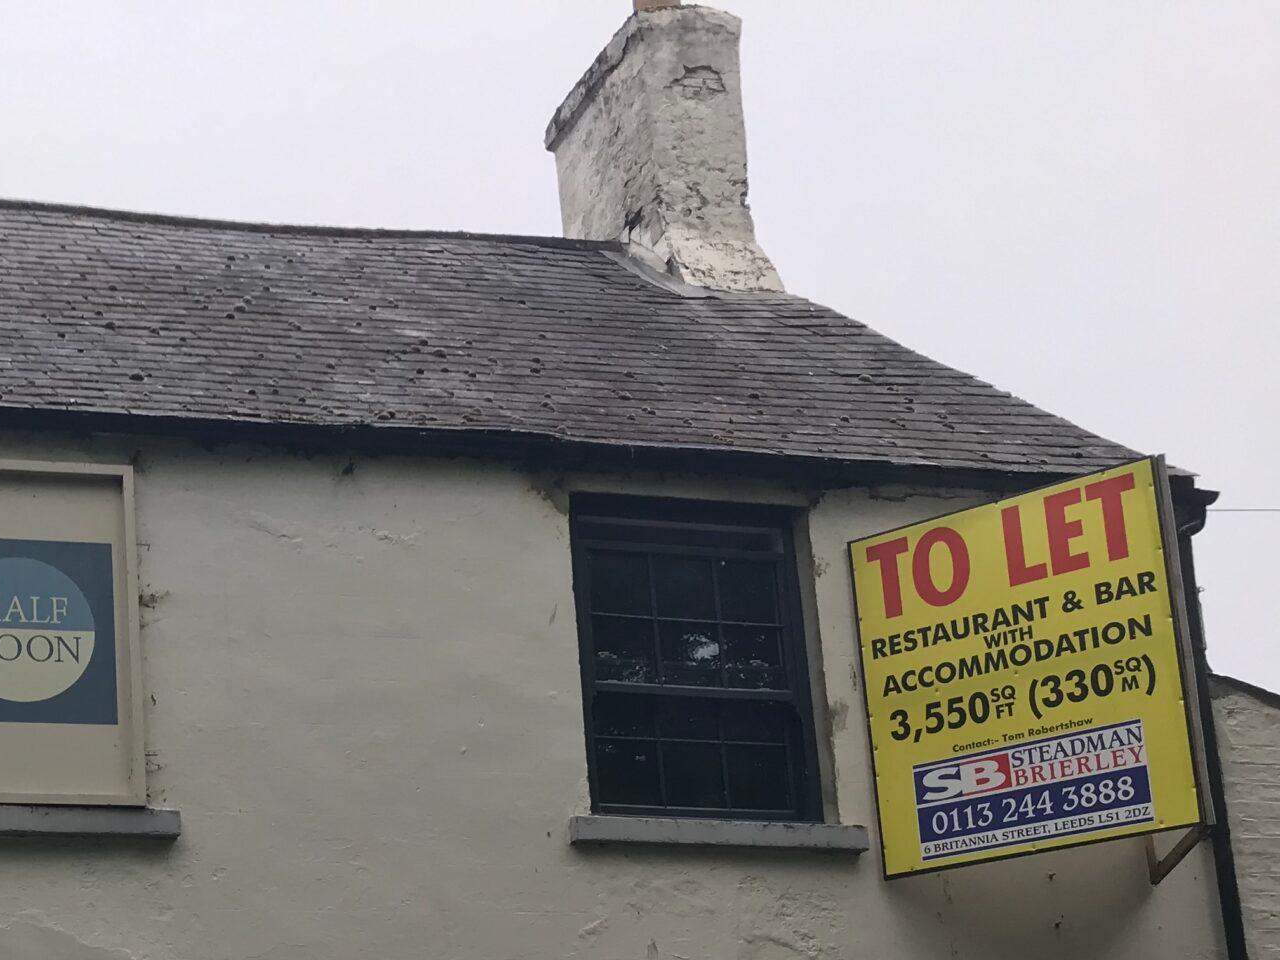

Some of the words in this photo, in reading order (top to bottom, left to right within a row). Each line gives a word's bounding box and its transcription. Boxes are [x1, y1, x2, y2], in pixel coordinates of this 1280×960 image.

[866, 527, 970, 619] TO
[1001, 473, 1136, 587] LET
[871, 596, 1050, 660] RESTAURANT
[1062, 590, 1083, 613] &
[1094, 570, 1157, 605] BAR
[983, 625, 1034, 649] WITH
[882, 614, 1152, 698] ACCOMMODATION
[889, 691, 990, 743] 3,550
[995, 702, 1015, 719] FT
[1001, 731, 1025, 742] Tom
[1028, 717, 1094, 737] Robertshaw
[1011, 726, 1143, 768] STEADMAN
[1013, 745, 1144, 786] BRIERLEY
[922, 760, 1007, 800] SB
[932, 802, 993, 835] 0113
[1001, 789, 1054, 823] 244
[1061, 776, 1135, 811] 3888
[924, 845, 931, 854] 6
[933, 834, 999, 853] BRITANNIA
[1054, 816, 1094, 831] LEEDS
[1098, 811, 1120, 824] LS1
[1124, 806, 1150, 819] 2DZ
